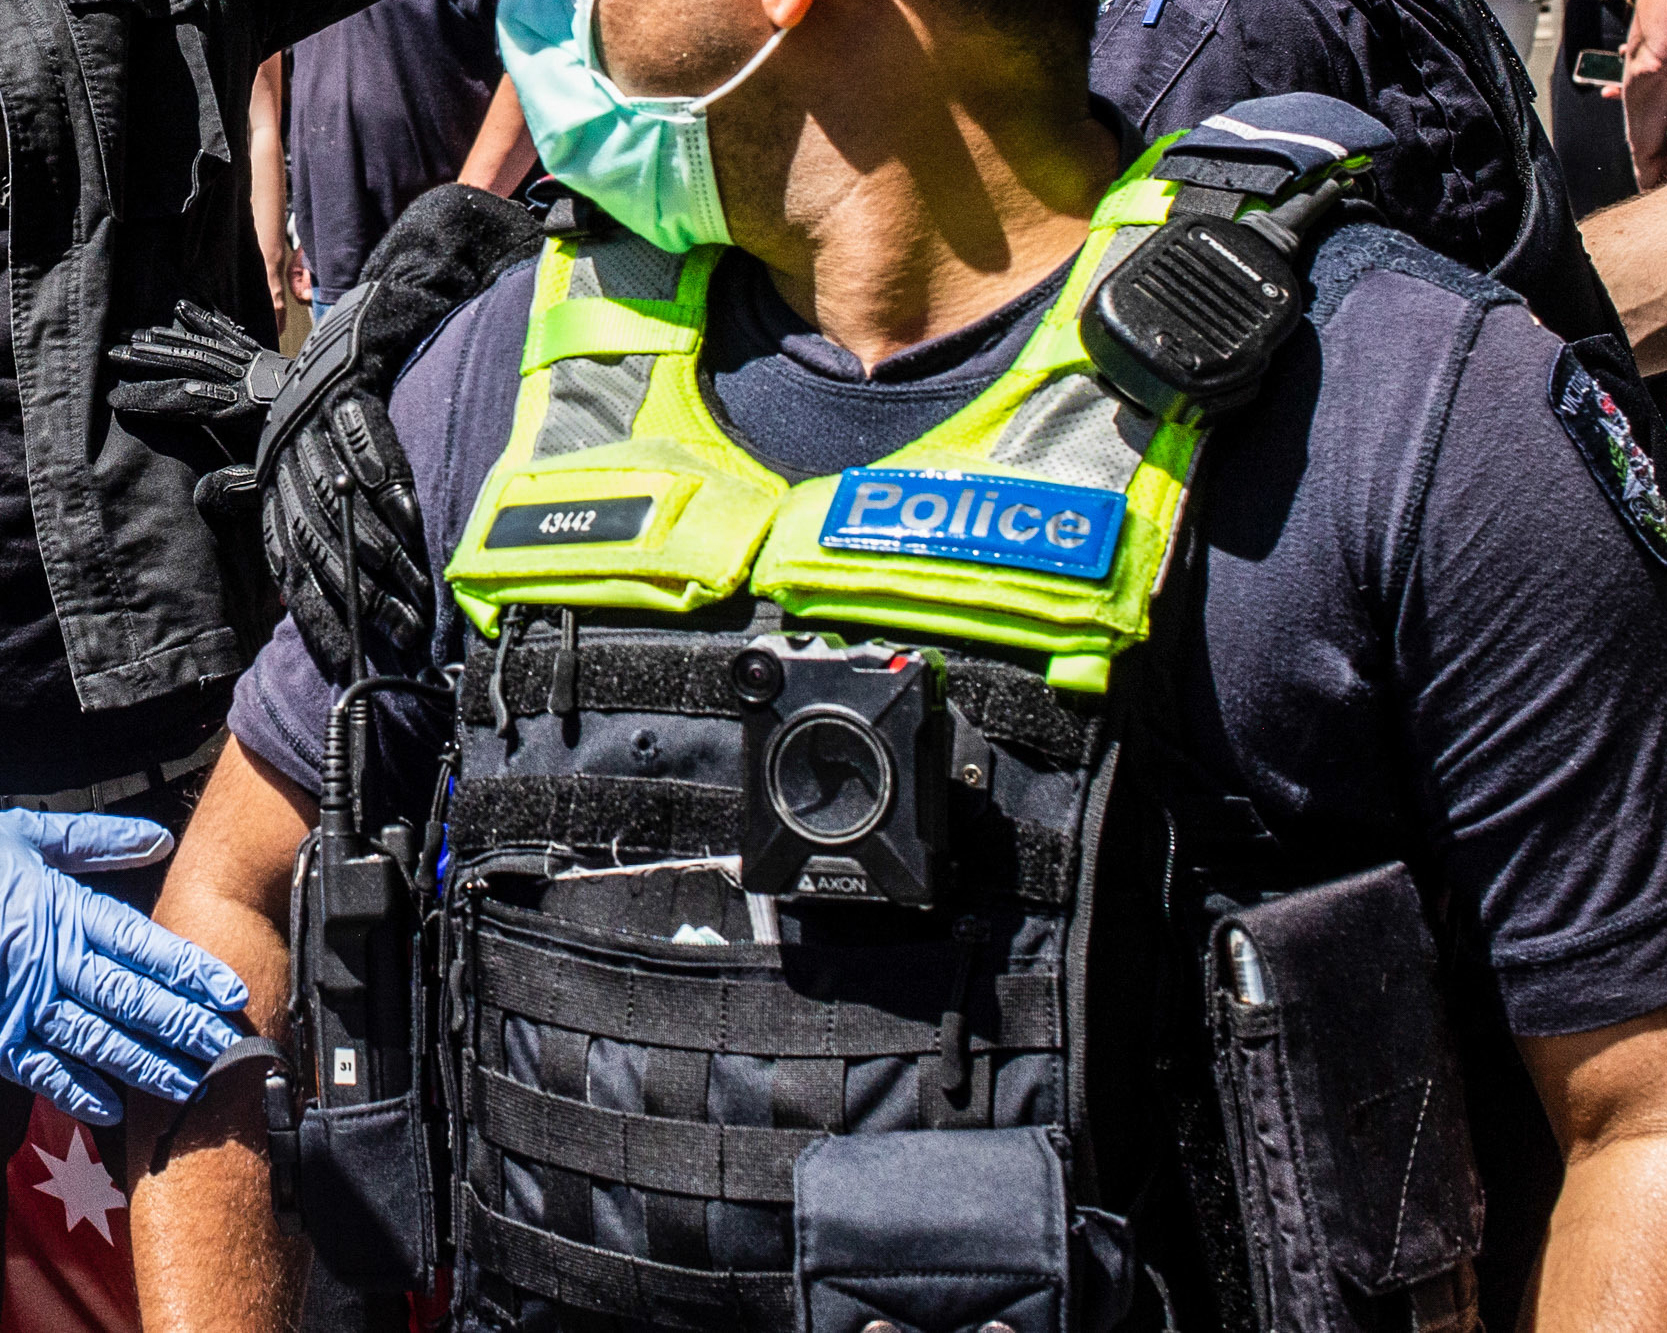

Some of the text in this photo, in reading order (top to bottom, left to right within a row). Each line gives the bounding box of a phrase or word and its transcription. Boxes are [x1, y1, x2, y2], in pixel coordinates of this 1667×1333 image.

[538, 510, 597, 534] 43442
[846, 481, 1092, 549] Police
[817, 876, 867, 893] AXON
[340, 1061, 352, 1072] 31
